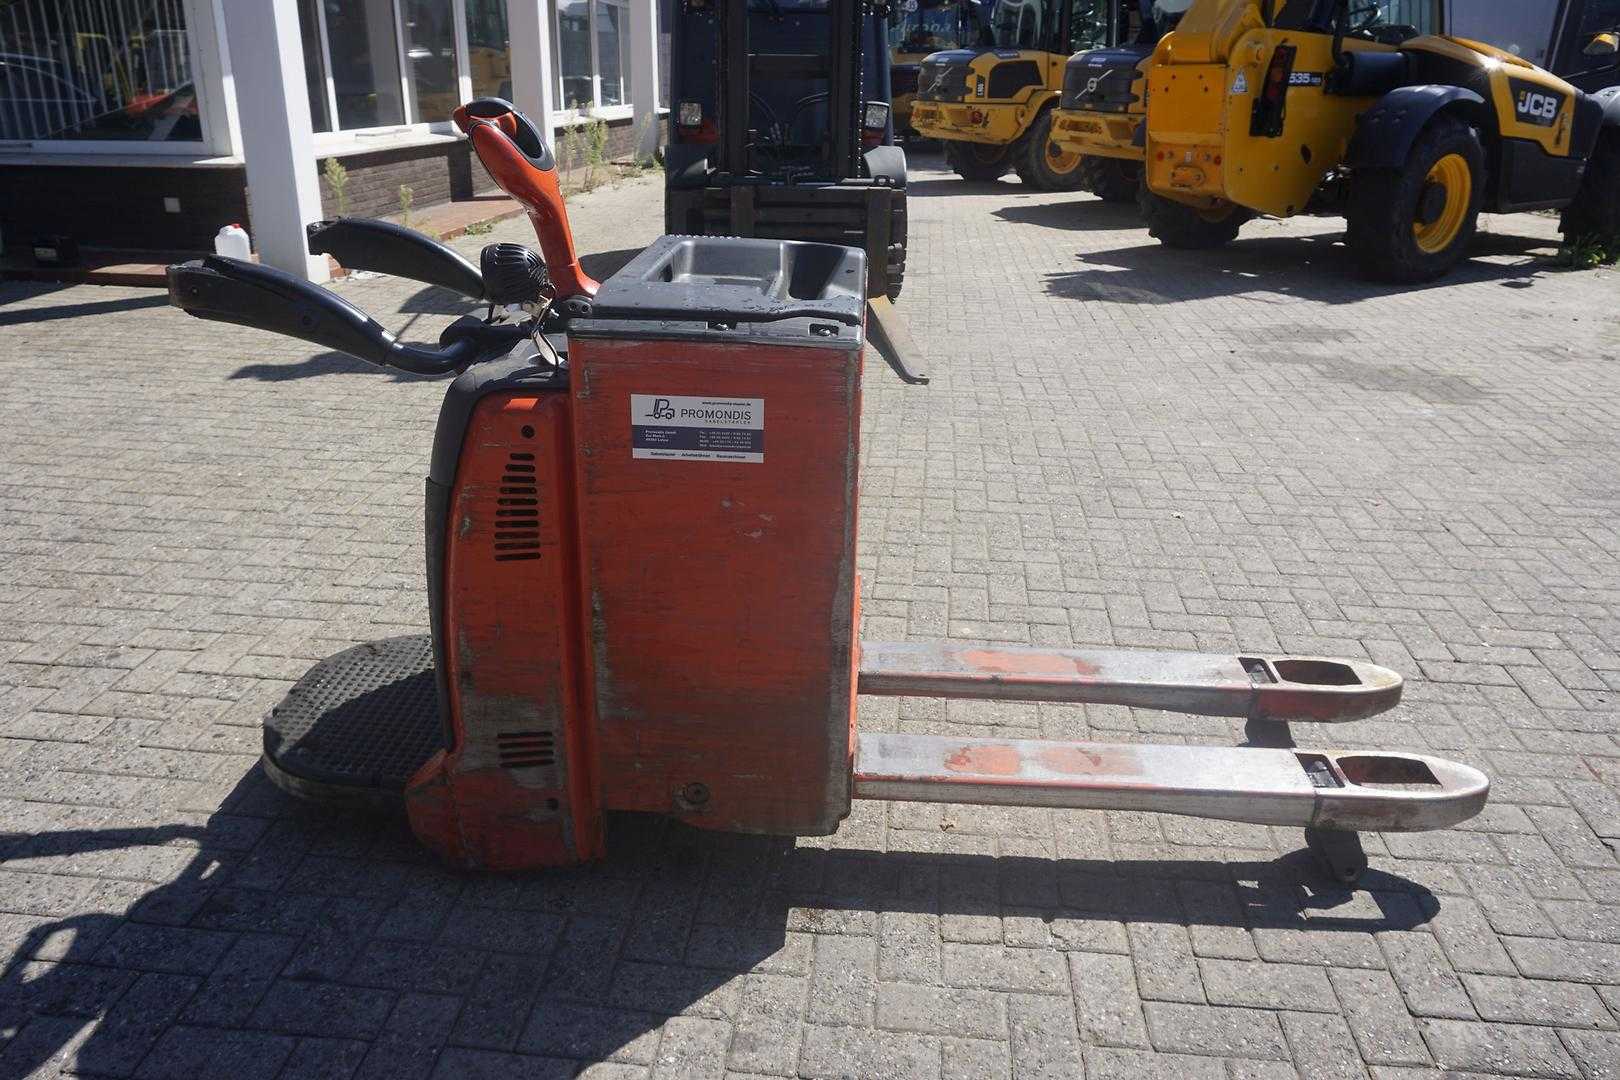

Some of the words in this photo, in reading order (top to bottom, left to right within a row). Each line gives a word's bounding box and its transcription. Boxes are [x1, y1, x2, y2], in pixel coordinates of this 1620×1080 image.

[1289, 73, 1310, 83] 535
[1517, 91, 1557, 118] JCB
[680, 409, 752, 420] PROMONDIS
